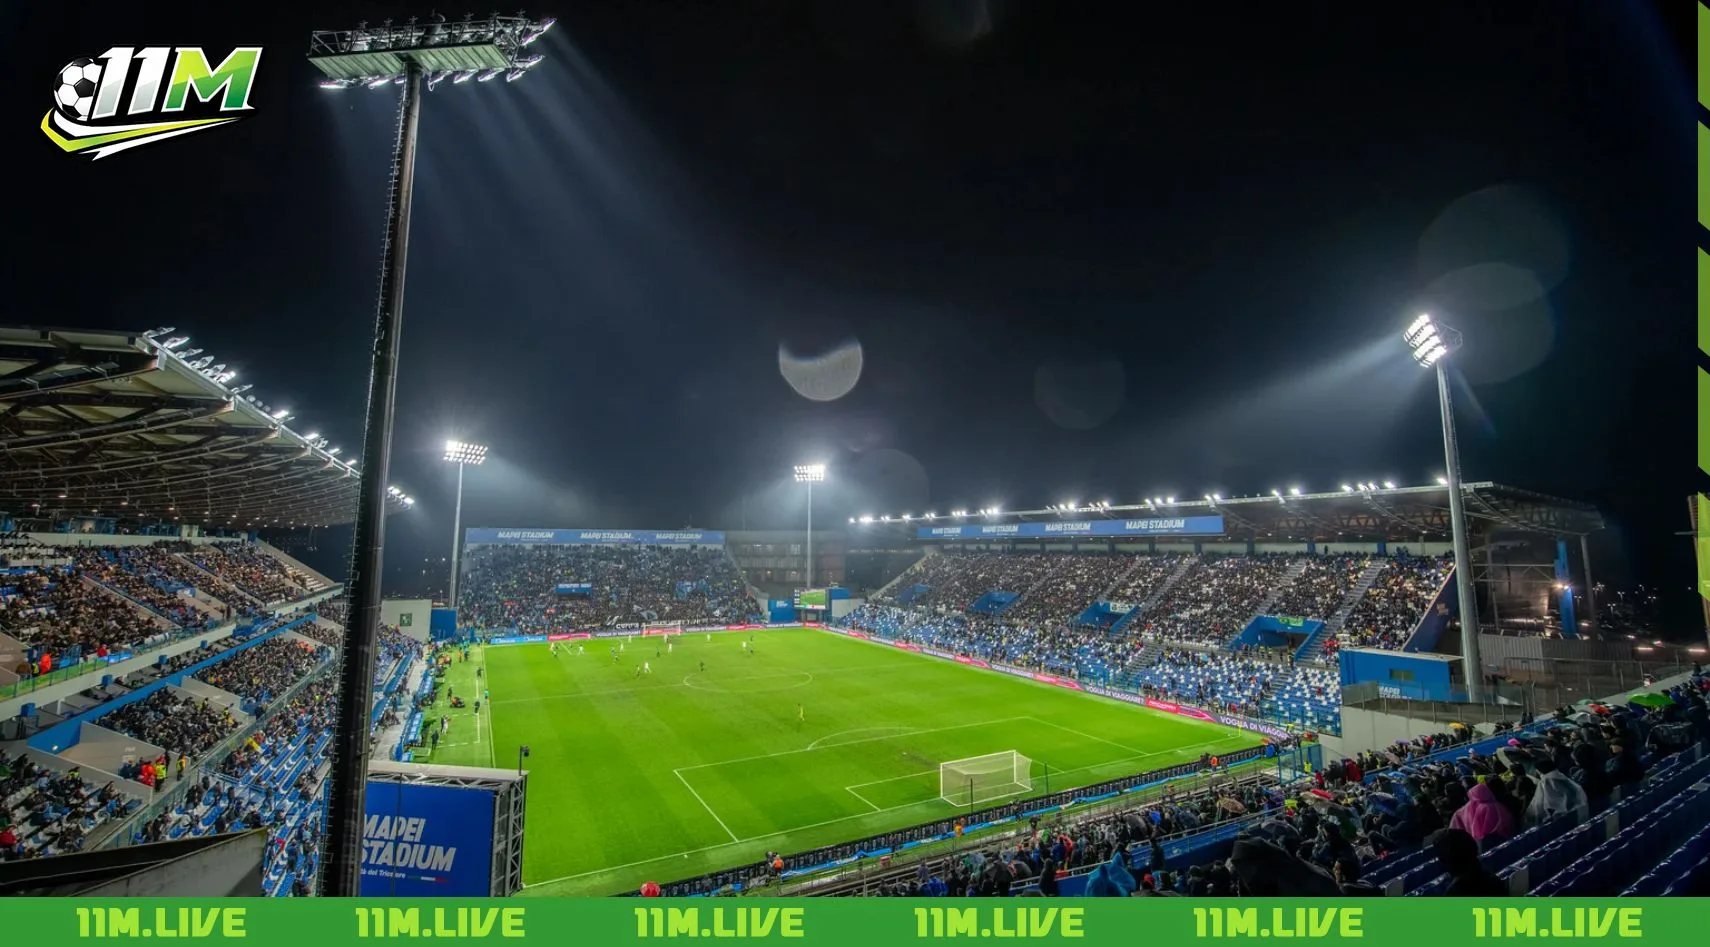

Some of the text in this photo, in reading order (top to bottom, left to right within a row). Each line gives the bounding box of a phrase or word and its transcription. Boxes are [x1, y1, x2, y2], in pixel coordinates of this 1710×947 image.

[1045, 522, 1091, 532] MAPEI STADIUM
[1125, 519, 1185, 529] MAPEI STADIUM
[363, 814, 426, 842] MAPEI
[361, 838, 457, 872] STADIUM
